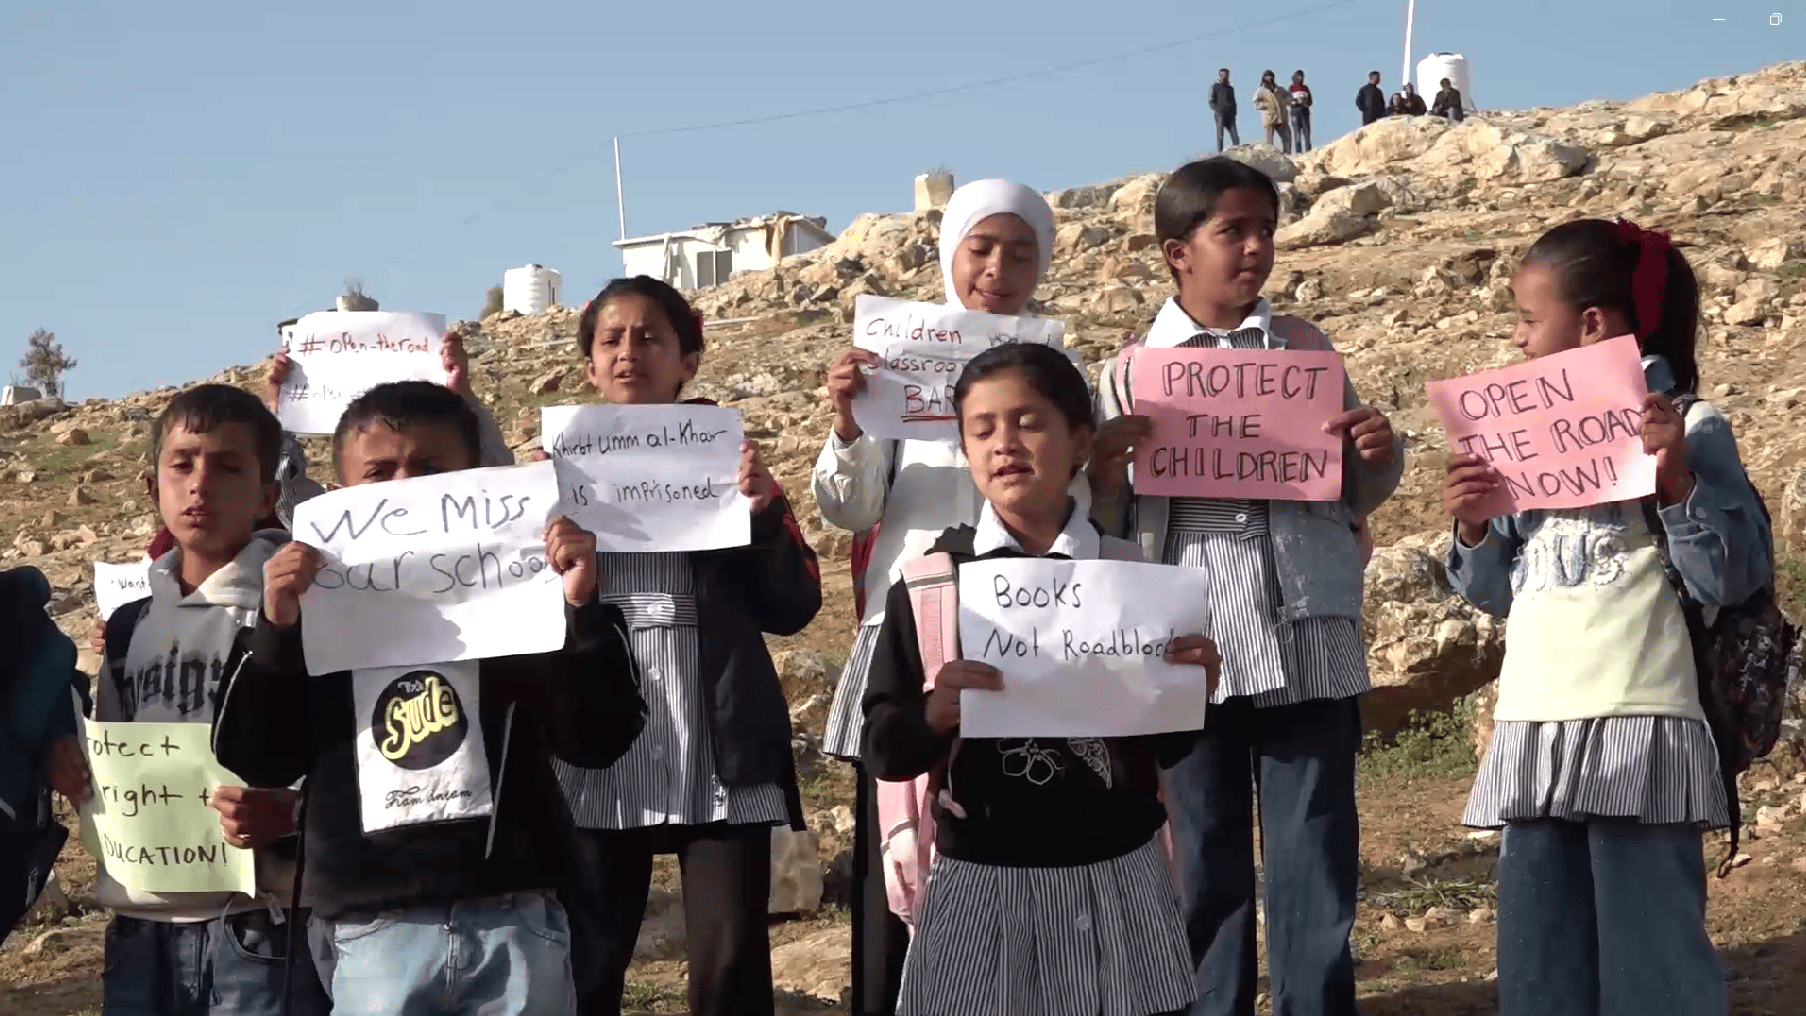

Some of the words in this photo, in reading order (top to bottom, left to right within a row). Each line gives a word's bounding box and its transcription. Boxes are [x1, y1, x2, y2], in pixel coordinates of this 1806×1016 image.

[866, 313, 963, 345] Children
[1161, 361, 1328, 400] PROTECT
[1458, 367, 1575, 422] OPEN
[1186, 413, 1262, 439] THE
[1458, 428, 1539, 464] THE
[1150, 446, 1328, 484] CHILDREN
[1503, 455, 1619, 501] NOW!
[309, 498, 428, 543] We
[313, 551, 415, 592] our
[430, 541, 548, 594] schoo
[993, 573, 1083, 608] Books
[983, 625, 1039, 658] Not
[86, 730, 182, 757] otect
[102, 783, 183, 817] right
